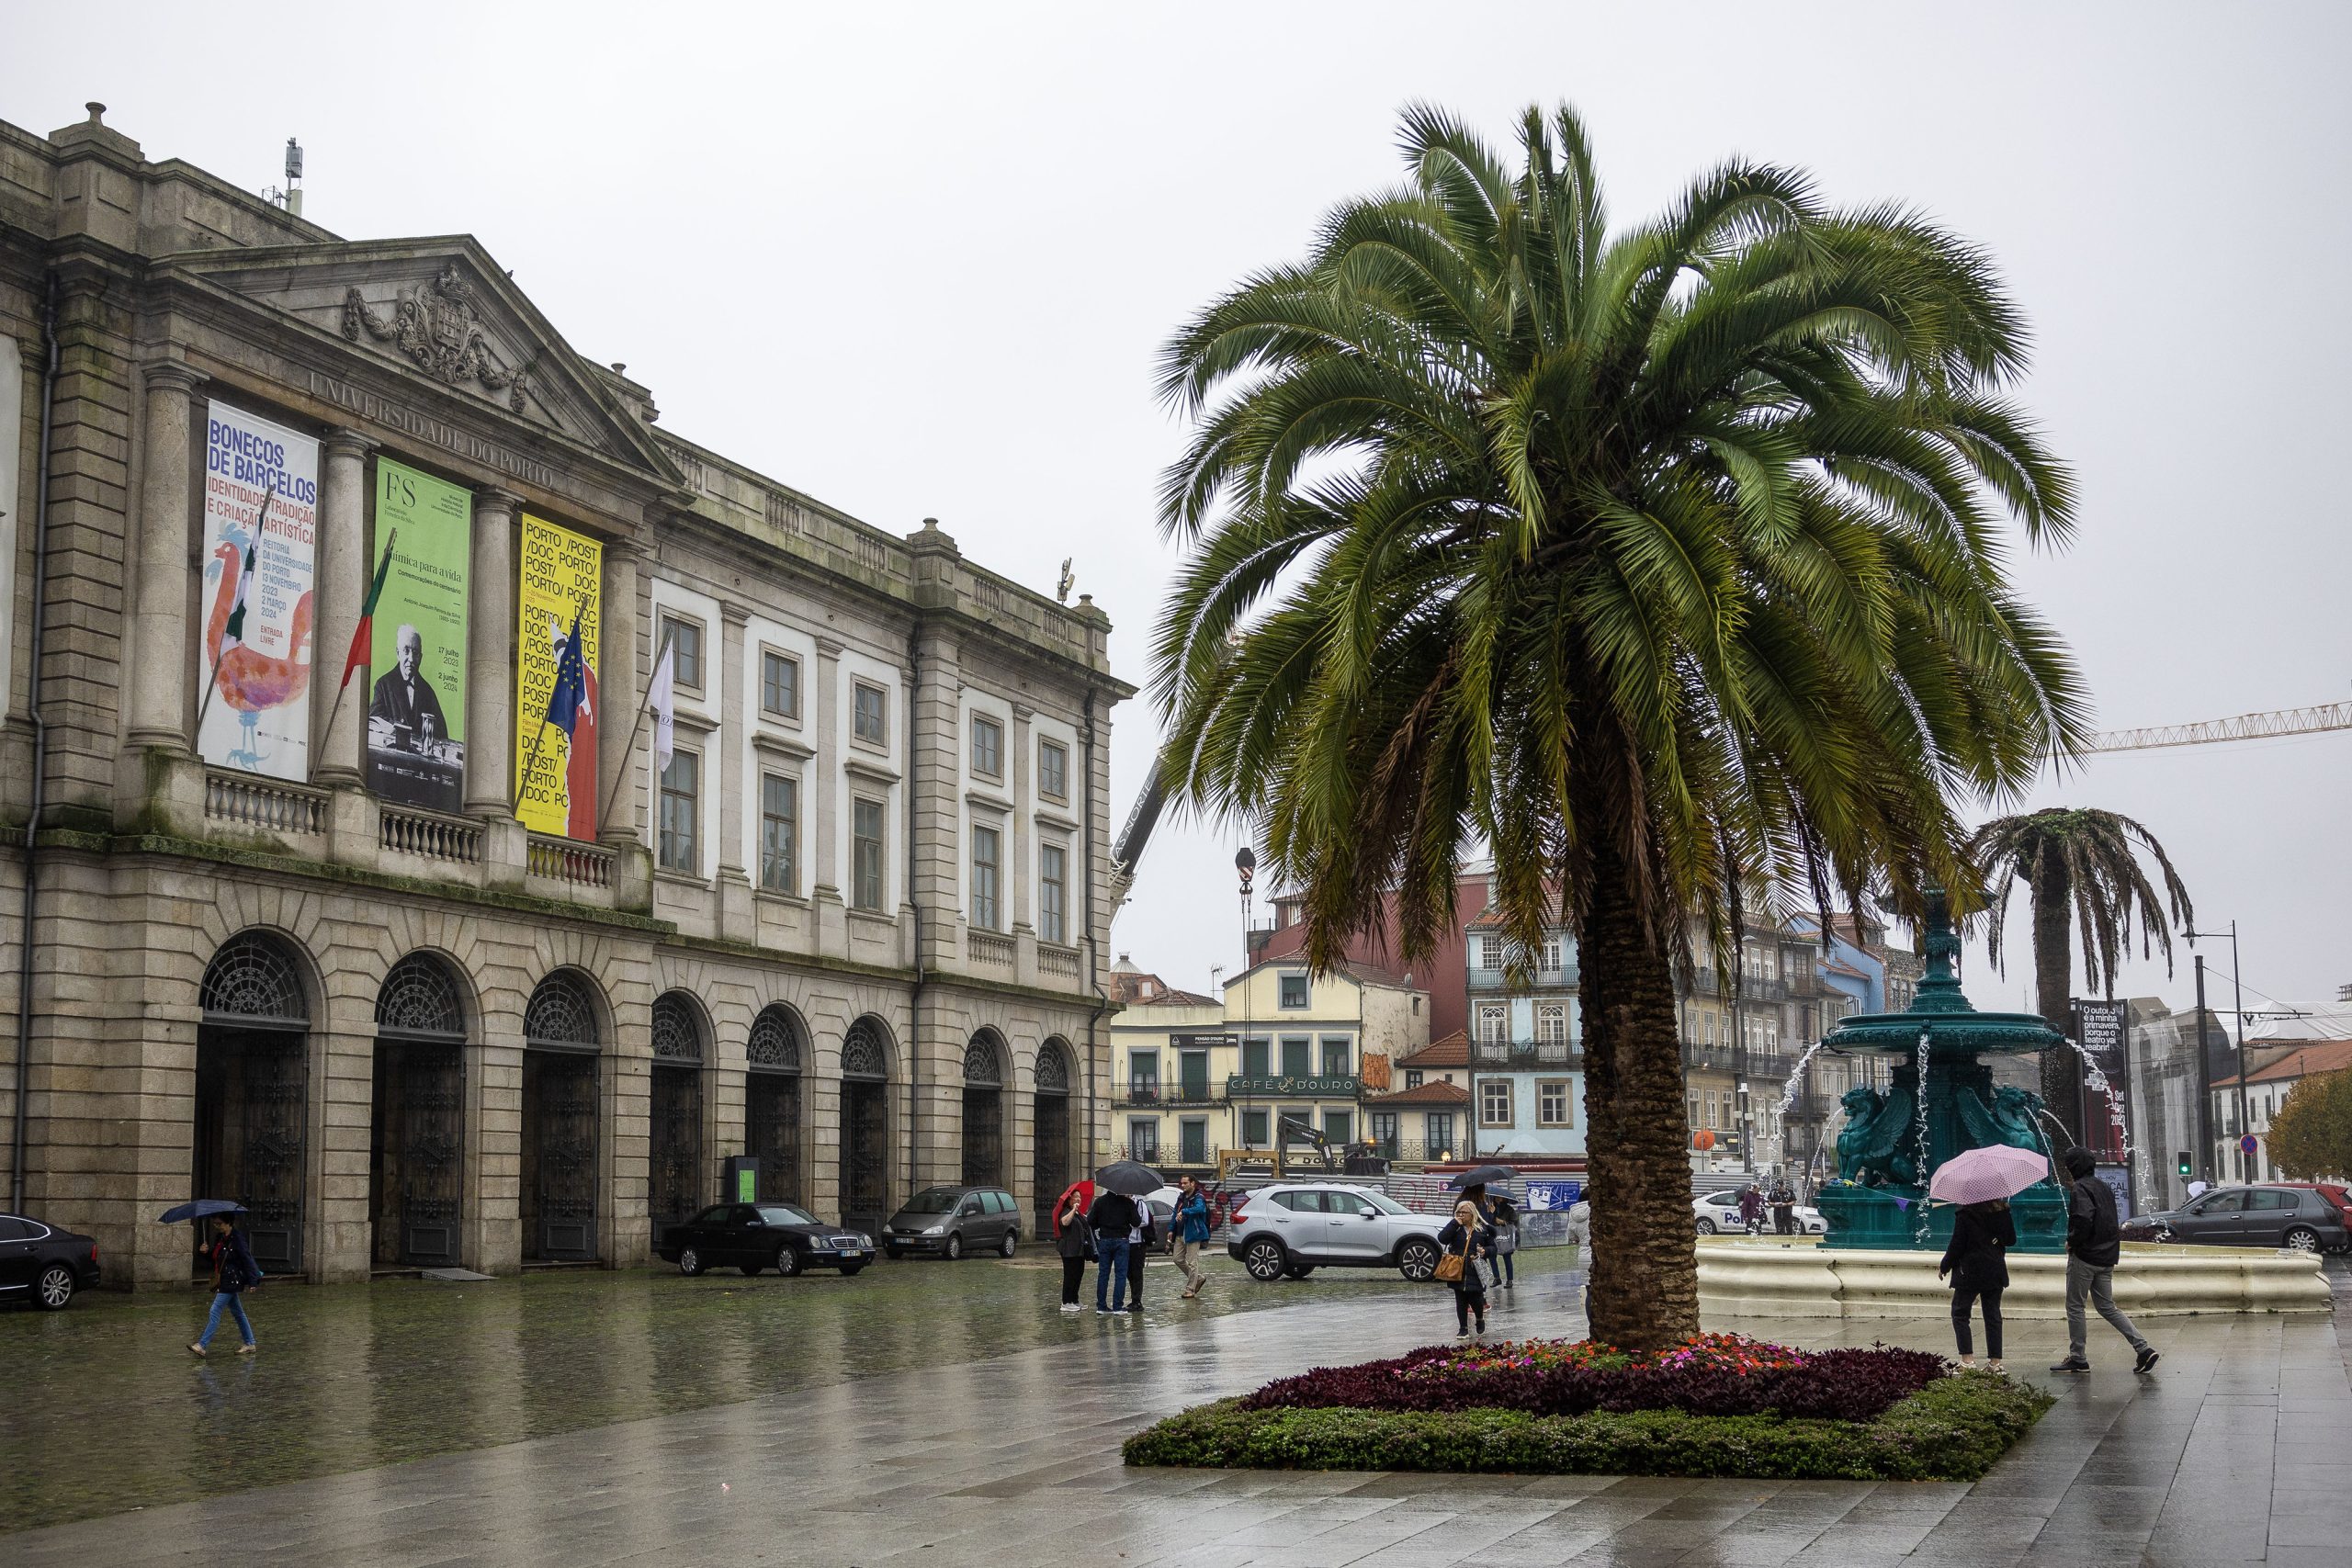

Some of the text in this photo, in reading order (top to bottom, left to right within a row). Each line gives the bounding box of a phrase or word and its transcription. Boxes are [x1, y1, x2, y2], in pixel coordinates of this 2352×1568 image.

[311, 372, 552, 488] UNIVERSIDADE DO PORTO
[209, 419, 285, 468] BONECOS
[209, 446, 316, 505] DE BARCELOS
[208, 476, 266, 508] IDENTIDADE
[386, 471, 416, 508] FS
[208, 497, 214, 513] E
[264, 516, 314, 546] ARTÍSTICA
[263, 538, 290, 554] REITORIA
[526, 523, 597, 558] PORTO /POST
[263, 550, 312, 574] DA UNIVERSIDADE
[390, 550, 461, 582] uímica para a vida
[526, 539, 597, 576] /DOC PORTO/
[262, 561, 290, 578] DO PORTO
[398, 569, 433, 585] Comemorações
[526, 556, 597, 592] POST/ DOC
[262, 573, 301, 592] 13 NOVEMBRO
[262, 584, 277, 597] 2023
[526, 572, 564, 597] PORTO/
[261, 595, 287, 613] 2 MARÇO
[261, 607, 277, 619] 2024
[260, 626, 283, 638] ENTRADA
[525, 620, 548, 639] DOC
[259, 636, 275, 646] LIVRE
[438, 646, 459, 658] 17 julho
[443, 656, 459, 668] 2023
[524, 653, 559, 675] PORTO
[443, 672, 458, 683] junho
[524, 670, 551, 689] /DOC
[443, 682, 458, 693] 2024
[522, 735, 546, 753] DOC
[2084, 1006, 2089, 1014] O
[2084, 1021, 2120, 1030] primavera,
[2106, 1036, 2117, 1044] vai
[1231, 1078, 1353, 1089] CAFÉ D'OURO
[2114, 1089, 2124, 1101] Set
